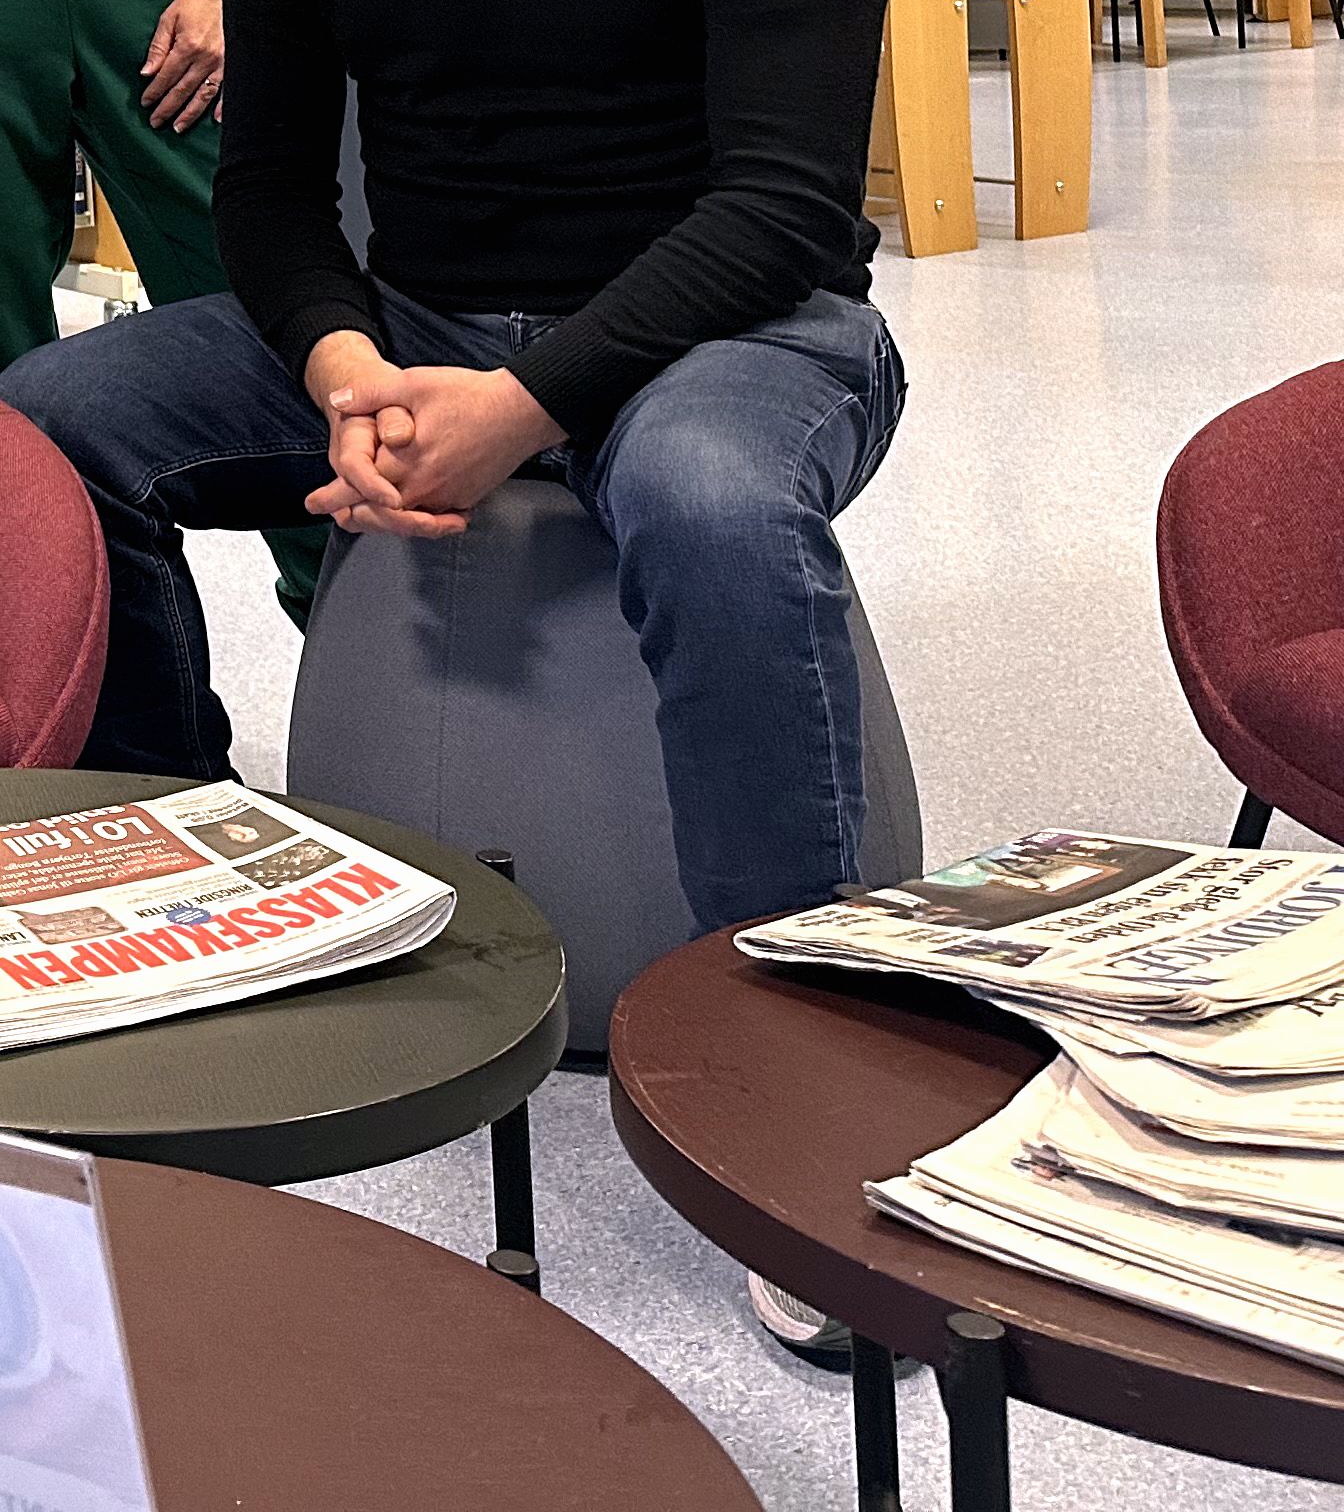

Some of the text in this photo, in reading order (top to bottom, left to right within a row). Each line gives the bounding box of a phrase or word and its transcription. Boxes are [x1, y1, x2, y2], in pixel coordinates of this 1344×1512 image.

[2, 816, 154, 857] LO i full
[1176, 857, 1244, 882] fekk
[1230, 858, 1294, 885] Stor
[192, 882, 253, 905] RINGSIDE
[1141, 880, 1189, 899] sin
[1178, 884, 1242, 913] glede
[1068, 919, 1157, 944] Olden
[1079, 864, 1344, 991] JORDINGEN
